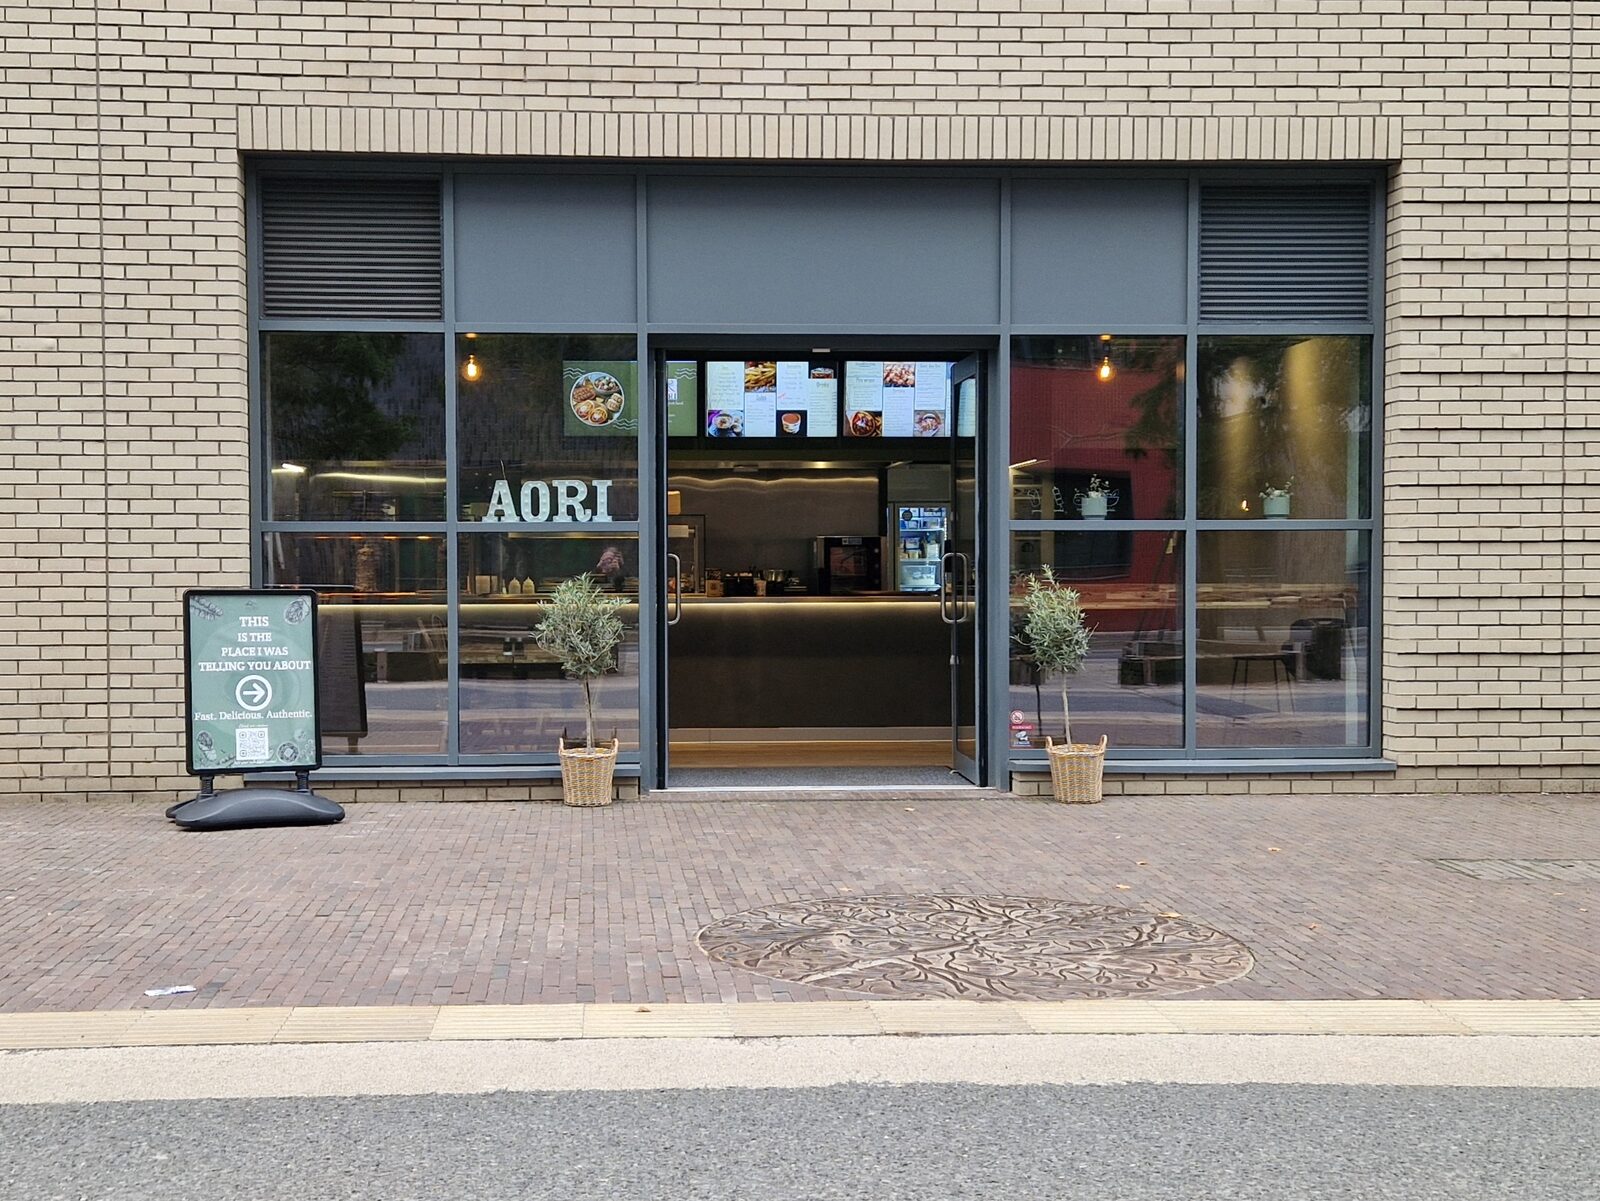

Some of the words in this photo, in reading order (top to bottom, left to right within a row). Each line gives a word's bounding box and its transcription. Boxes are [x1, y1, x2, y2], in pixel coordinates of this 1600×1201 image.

[482, 480, 613, 523] AORI
[240, 616, 269, 626] THIS
[238, 633, 247, 642] IS
[249, 633, 272, 641] THE
[222, 647, 255, 656] PLACE
[258, 647, 261, 655] I
[264, 647, 288, 655] WAS
[199, 662, 245, 671] TELLING
[247, 661, 271, 670] YOU
[273, 661, 311, 670] ABOUT
[195, 712, 216, 721] Fast.
[220, 711, 264, 720] Delicious.
[267, 709, 312, 718] Authentic.
